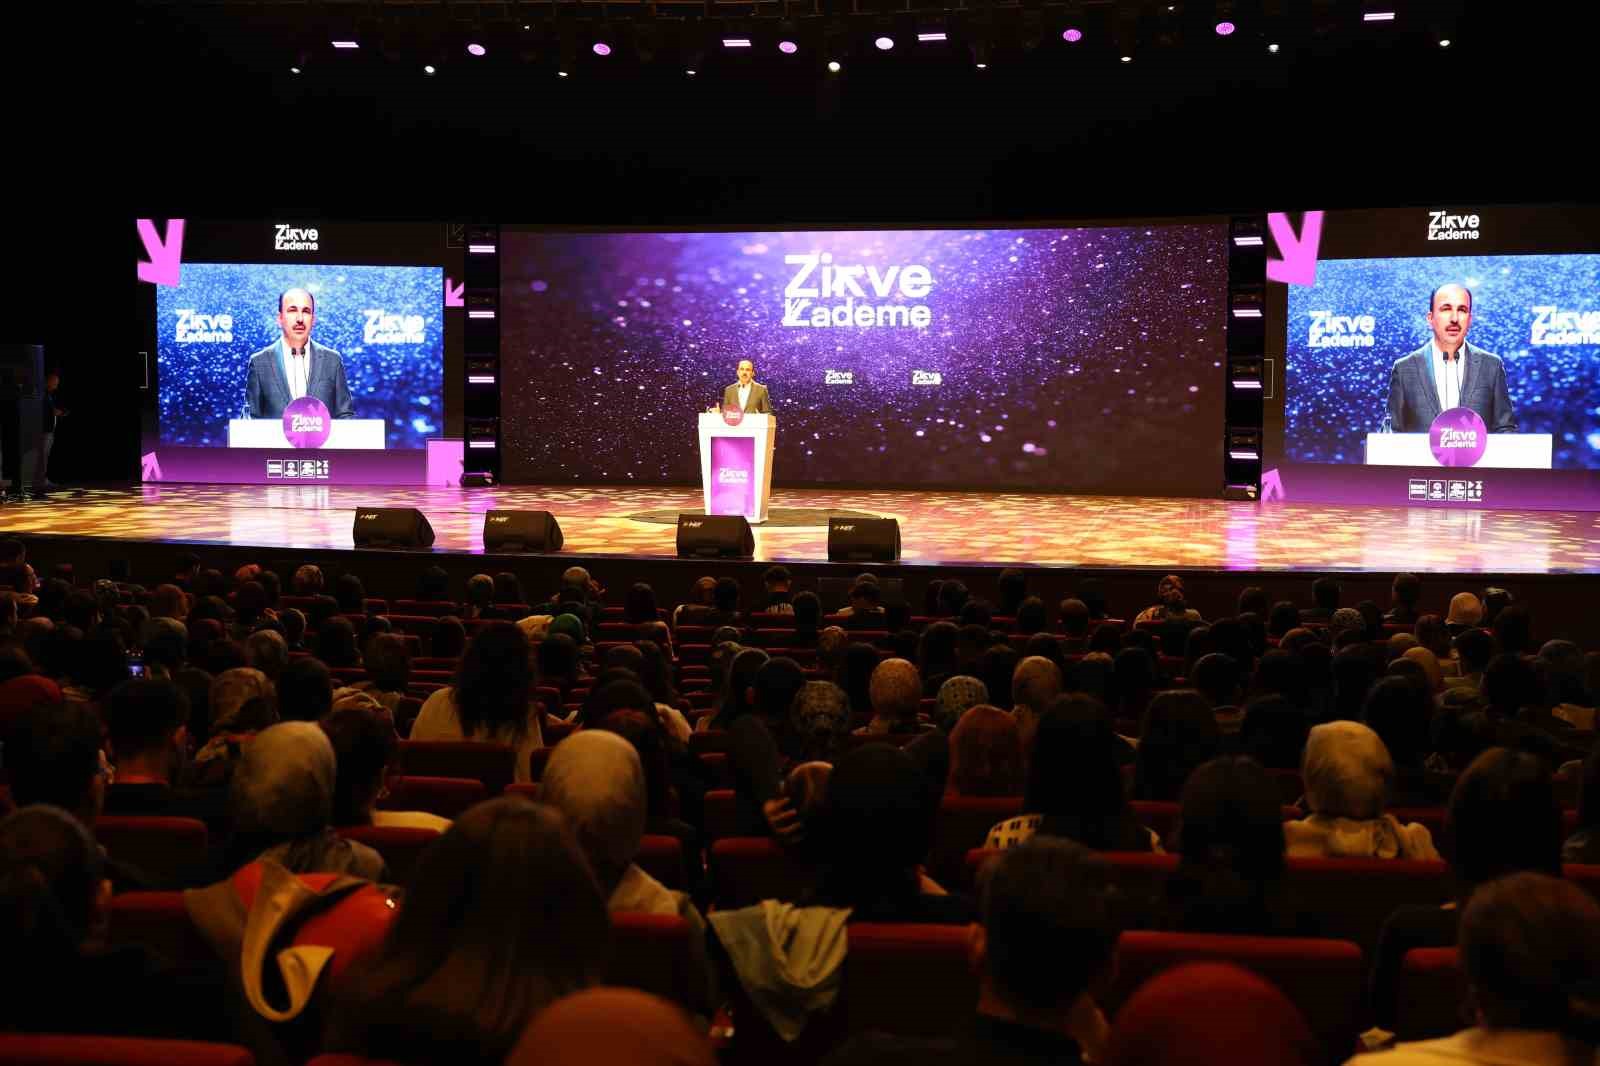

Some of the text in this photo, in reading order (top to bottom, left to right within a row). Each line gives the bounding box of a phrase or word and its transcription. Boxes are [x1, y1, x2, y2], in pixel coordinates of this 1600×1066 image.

[1428, 211, 1480, 229] Zirve
[275, 224, 319, 240] Zirve
[784, 252, 933, 298] Zirve
[174, 309, 233, 331] Zirve
[362, 309, 425, 332] Zirve
[1308, 310, 1376, 333] Zirve
[291, 414, 323, 425] Zirve
[1439, 428, 1477, 442] Zirve
